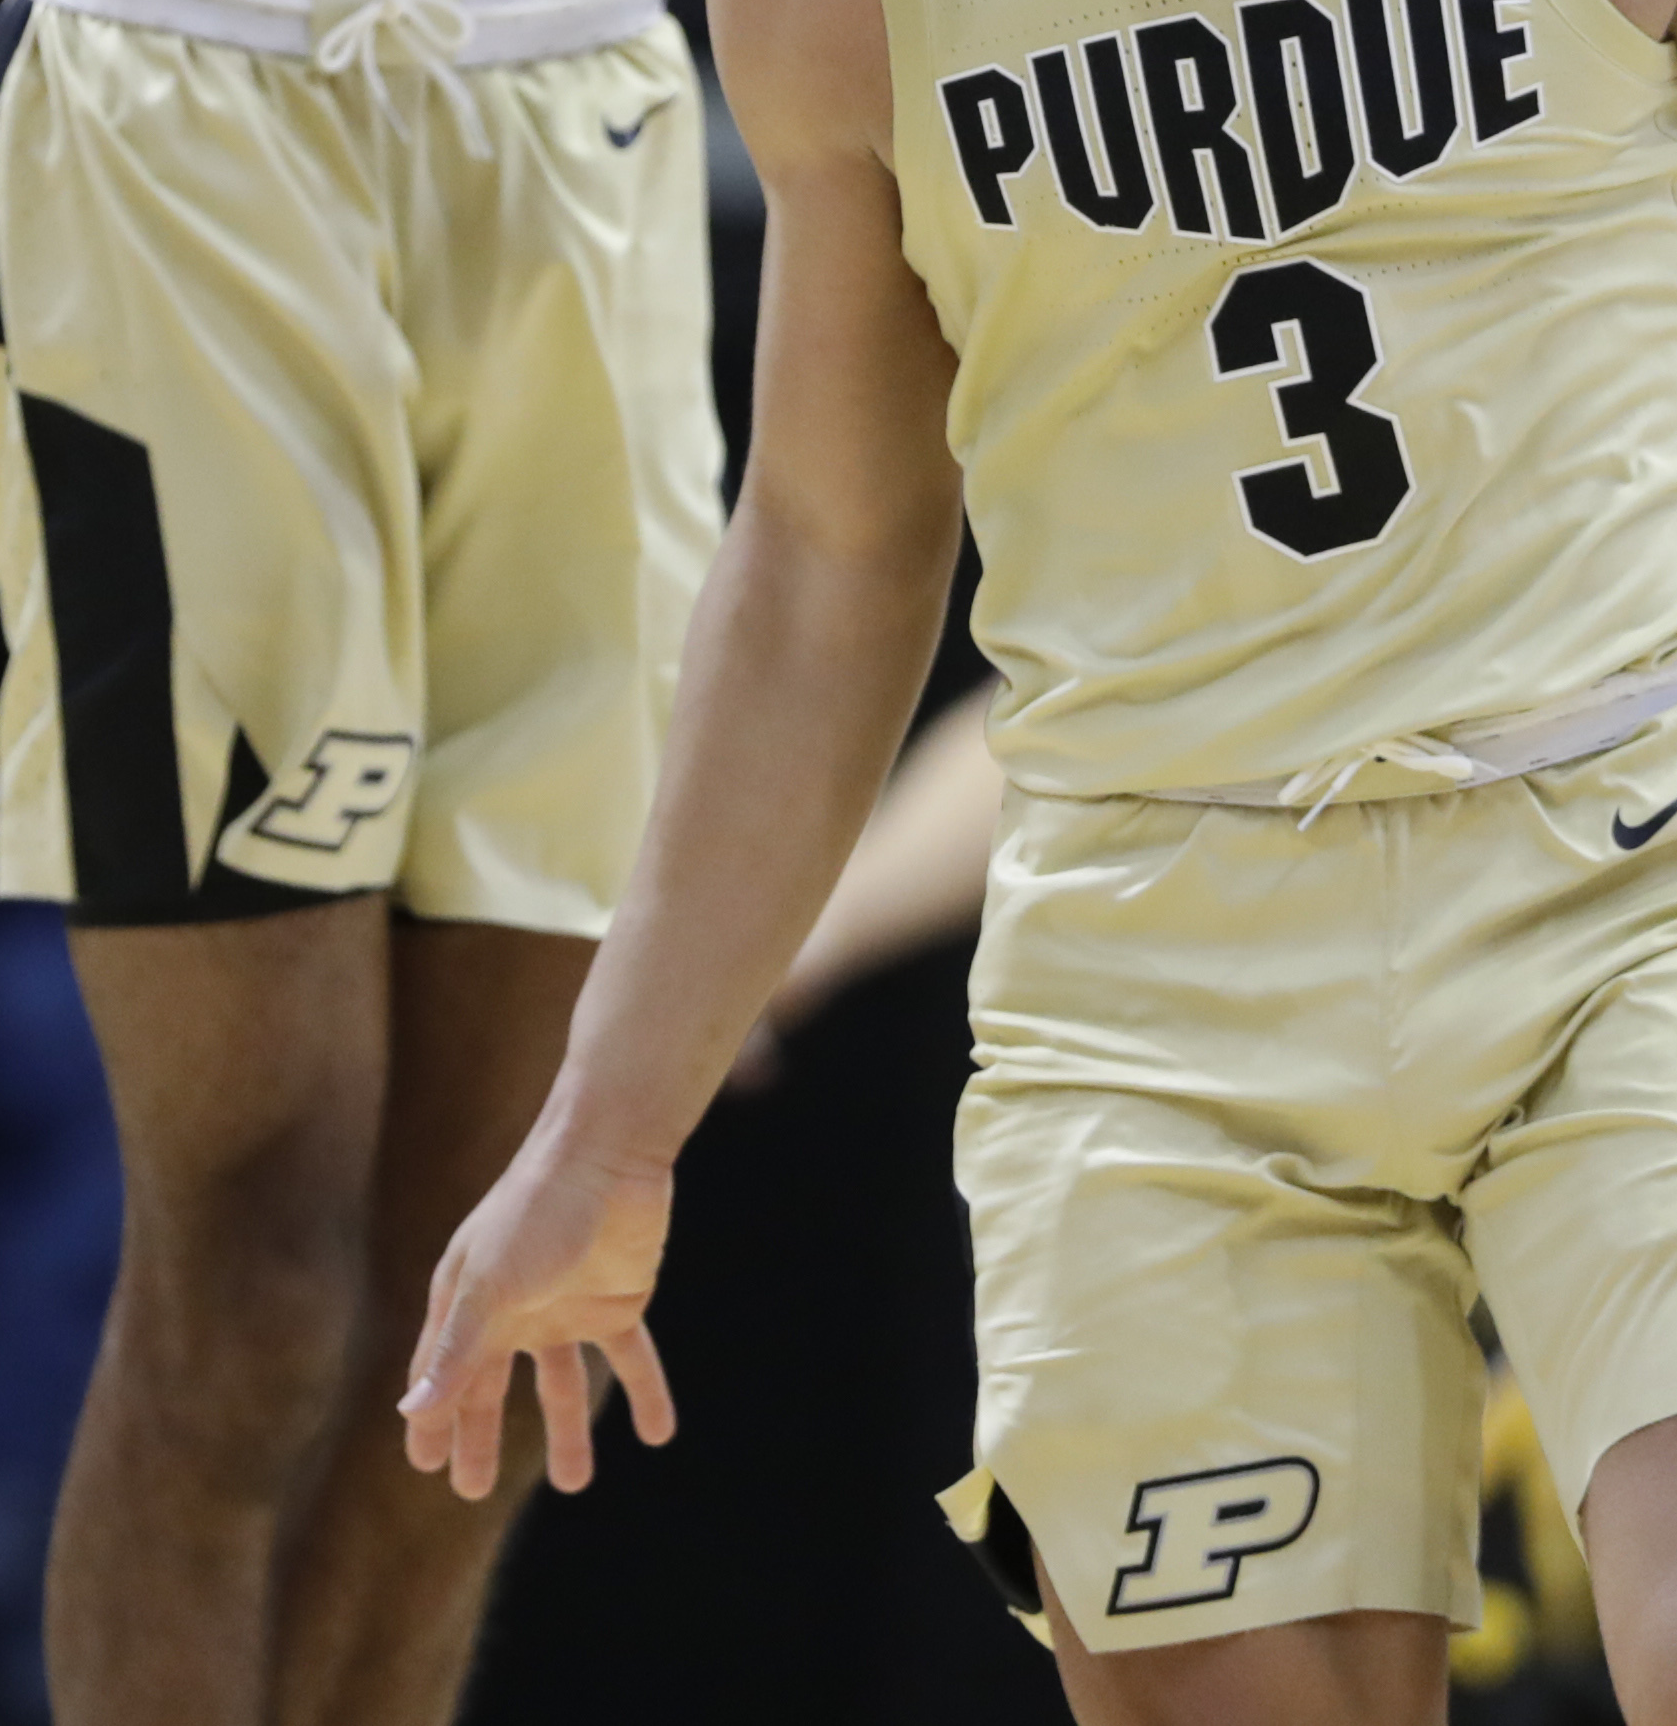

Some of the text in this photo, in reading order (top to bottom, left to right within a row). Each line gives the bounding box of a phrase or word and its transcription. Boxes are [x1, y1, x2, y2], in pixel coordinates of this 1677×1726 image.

[1203, 257, 1417, 564] 3
[250, 728, 415, 852] P
[1105, 1455, 1321, 1617] P
